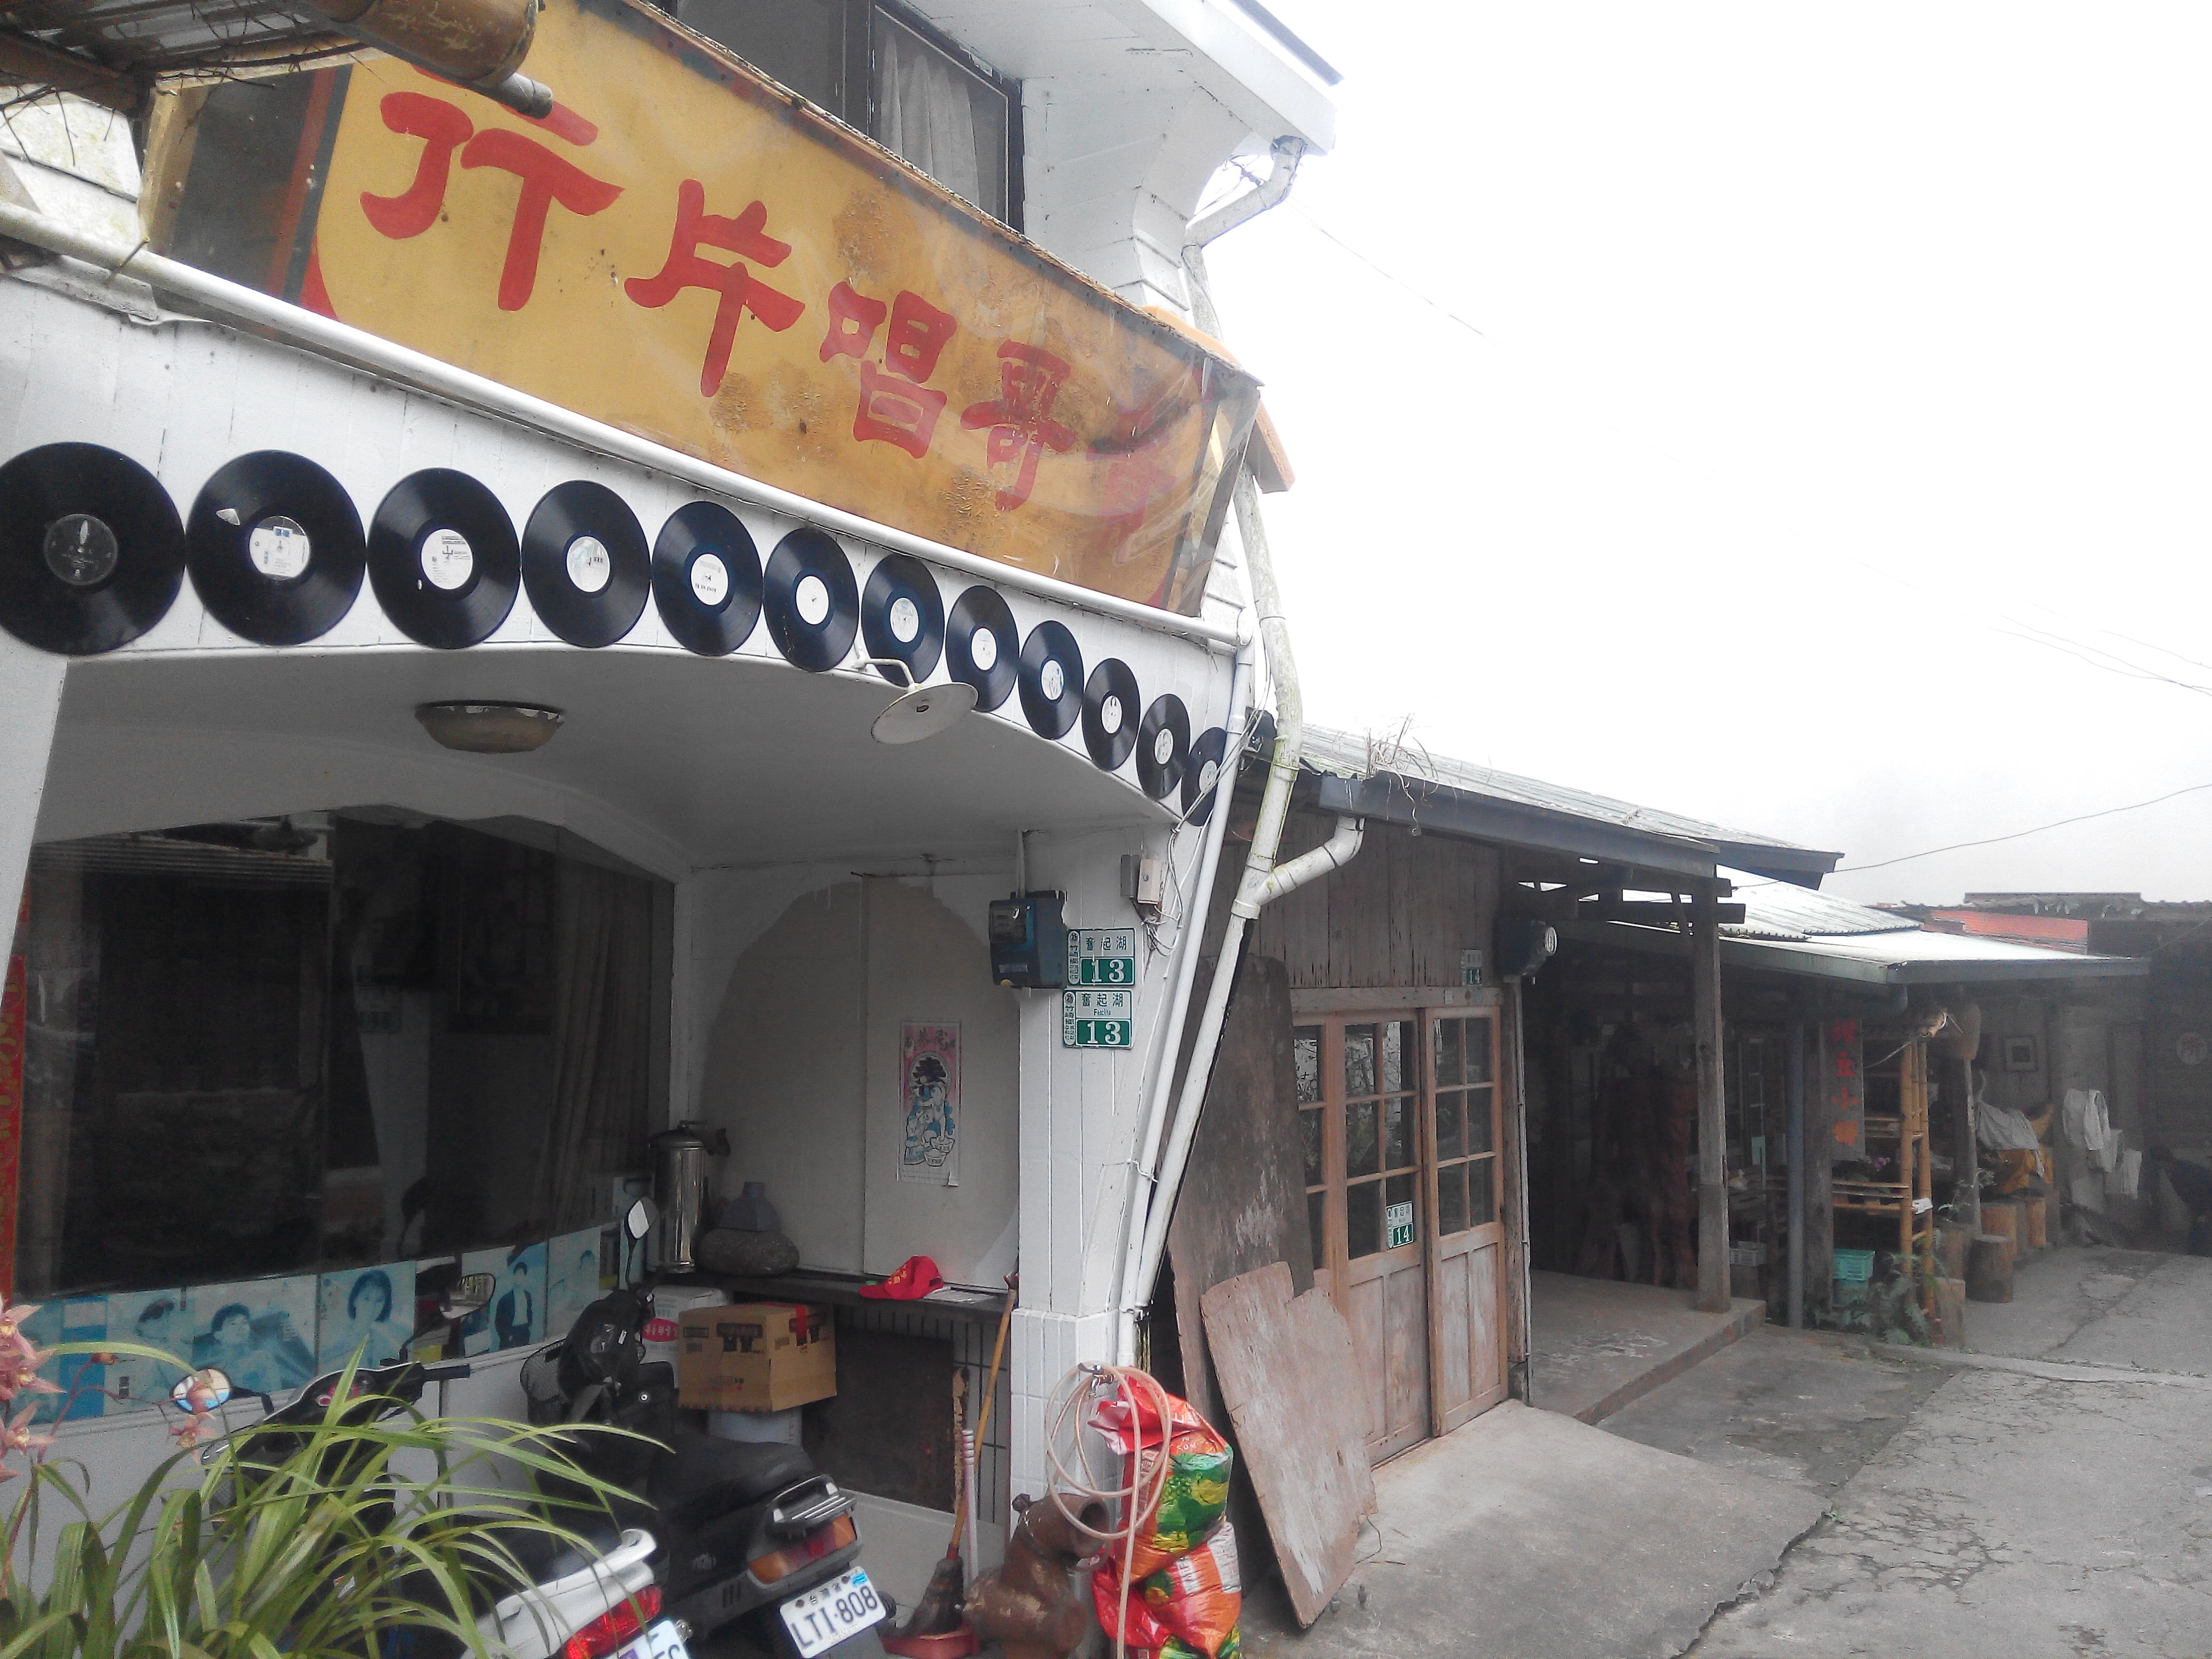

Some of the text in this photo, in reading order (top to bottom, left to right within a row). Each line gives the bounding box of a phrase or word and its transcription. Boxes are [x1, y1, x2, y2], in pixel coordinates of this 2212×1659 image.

[1086, 936, 1127, 951] 奮起湖
[1091, 959, 1125, 983] 13
[1469, 968, 1481, 984] 14
[1082, 993, 1123, 1007] 奮起湖
[1087, 1021, 1121, 1044] 13
[1396, 1225, 1410, 1244] 14
